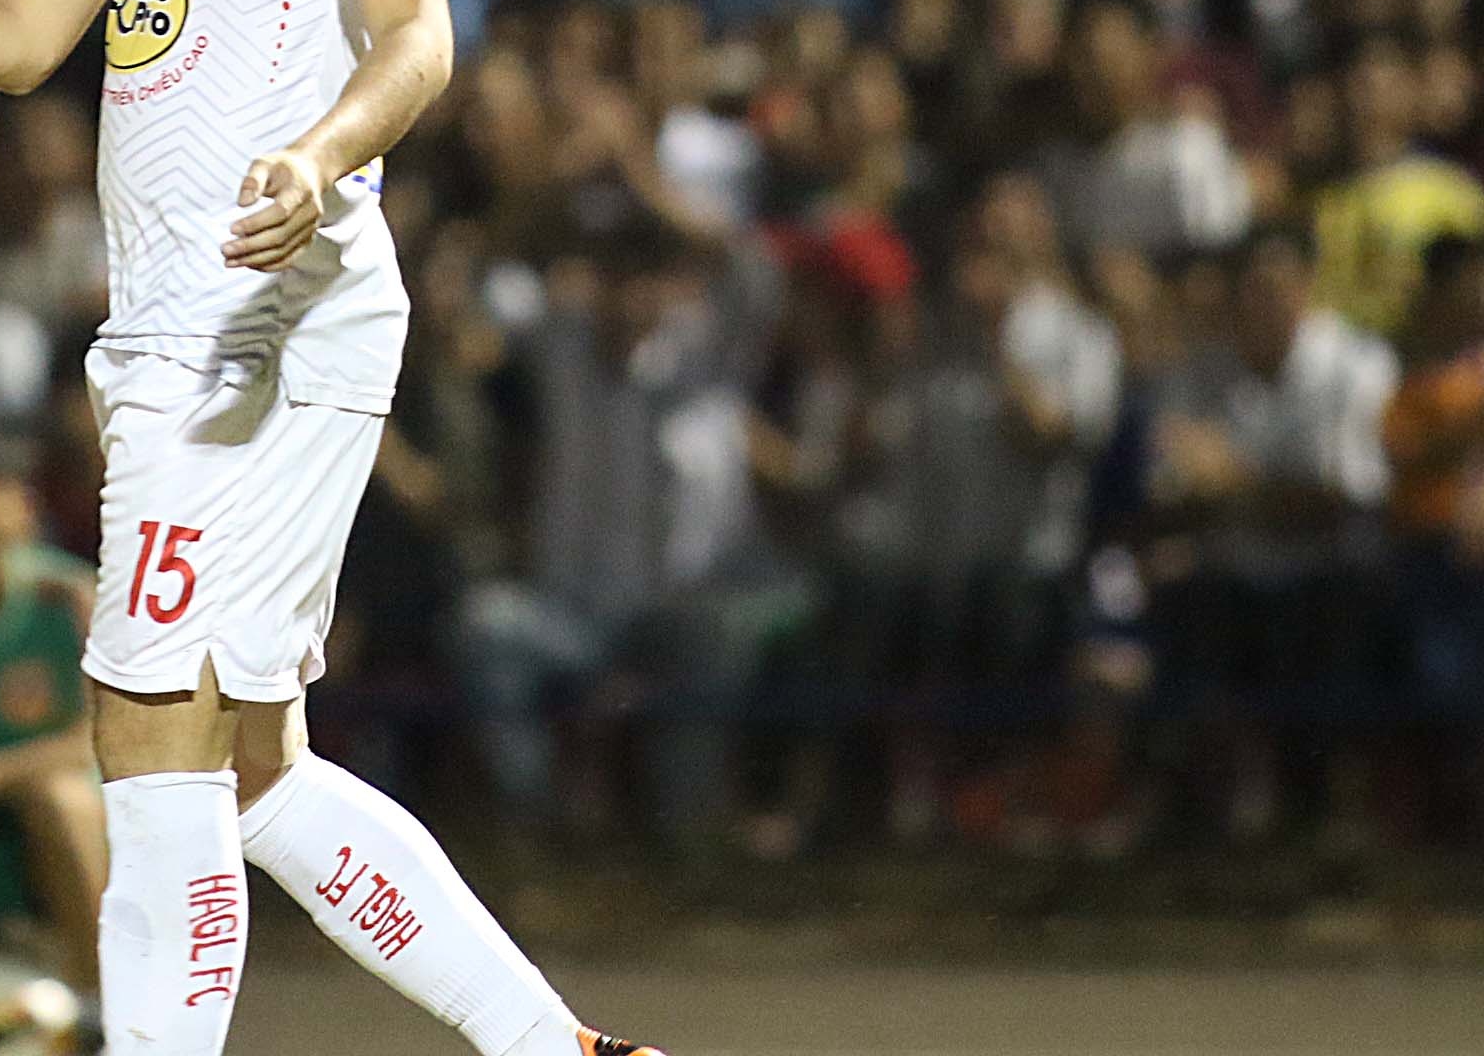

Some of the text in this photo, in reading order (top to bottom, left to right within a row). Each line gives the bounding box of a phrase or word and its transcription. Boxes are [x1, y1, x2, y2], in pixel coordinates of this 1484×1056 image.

[182, 35, 209, 71] CAO
[127, 520, 204, 625] 15
[185, 874, 238, 1008] HAGL FC
[315, 846, 423, 961] HAGL FC
